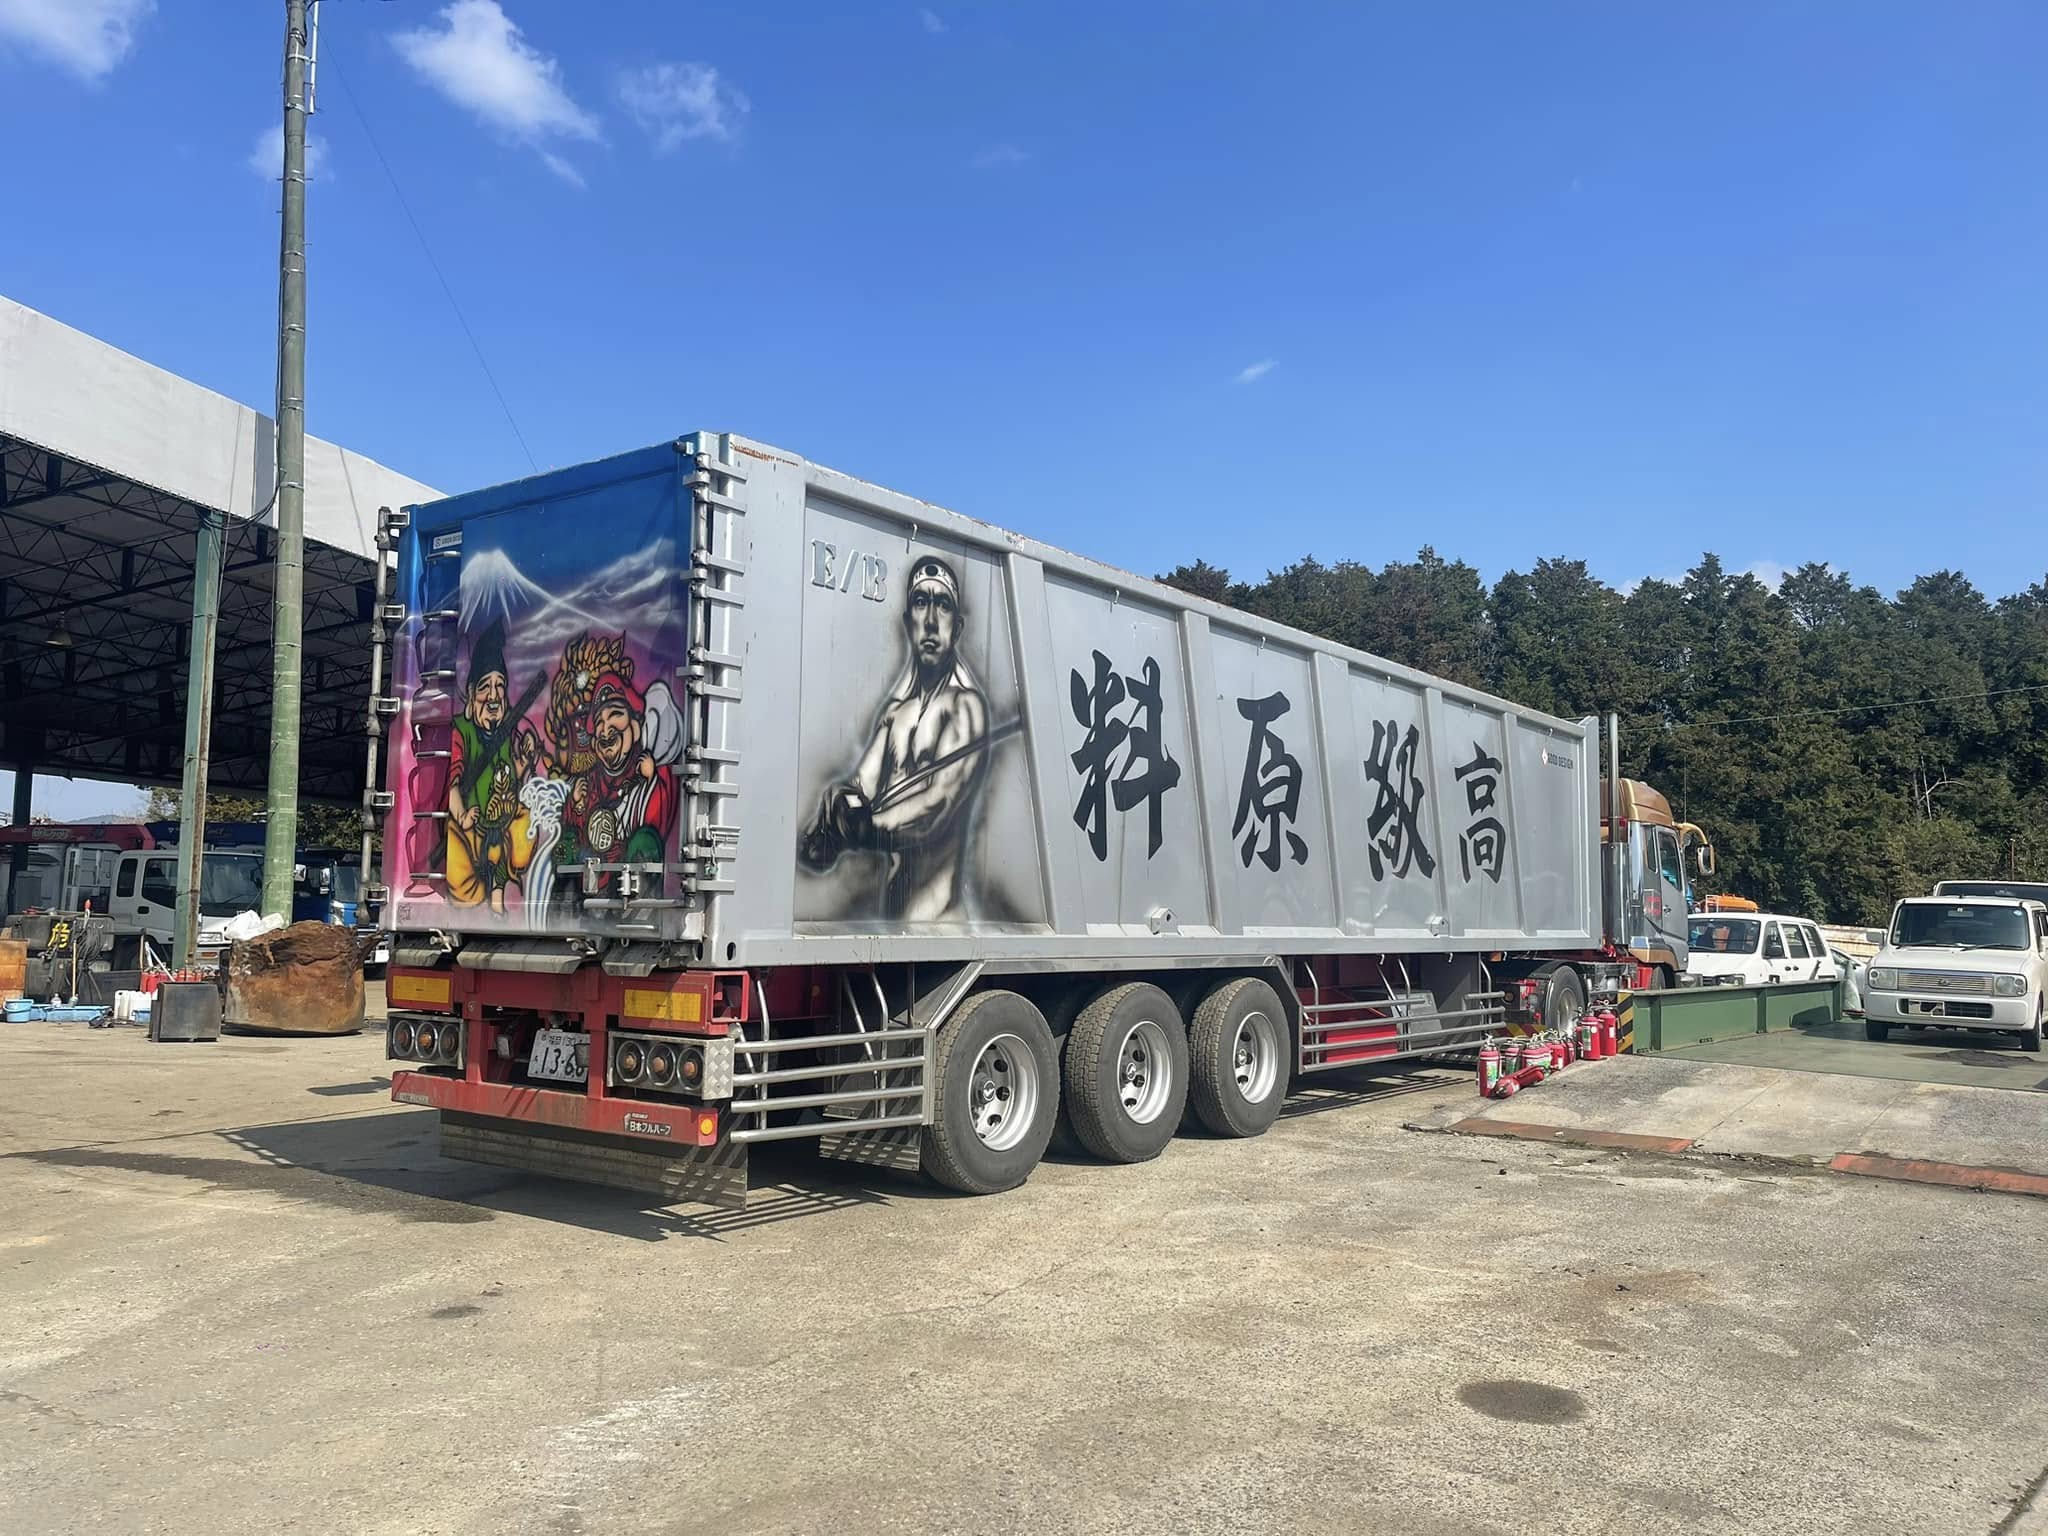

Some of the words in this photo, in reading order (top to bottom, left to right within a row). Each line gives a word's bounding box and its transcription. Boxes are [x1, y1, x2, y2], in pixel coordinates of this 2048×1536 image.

[811, 538, 888, 602] E/B
[629, 1120, 671, 1135] 日本フルハーフ
